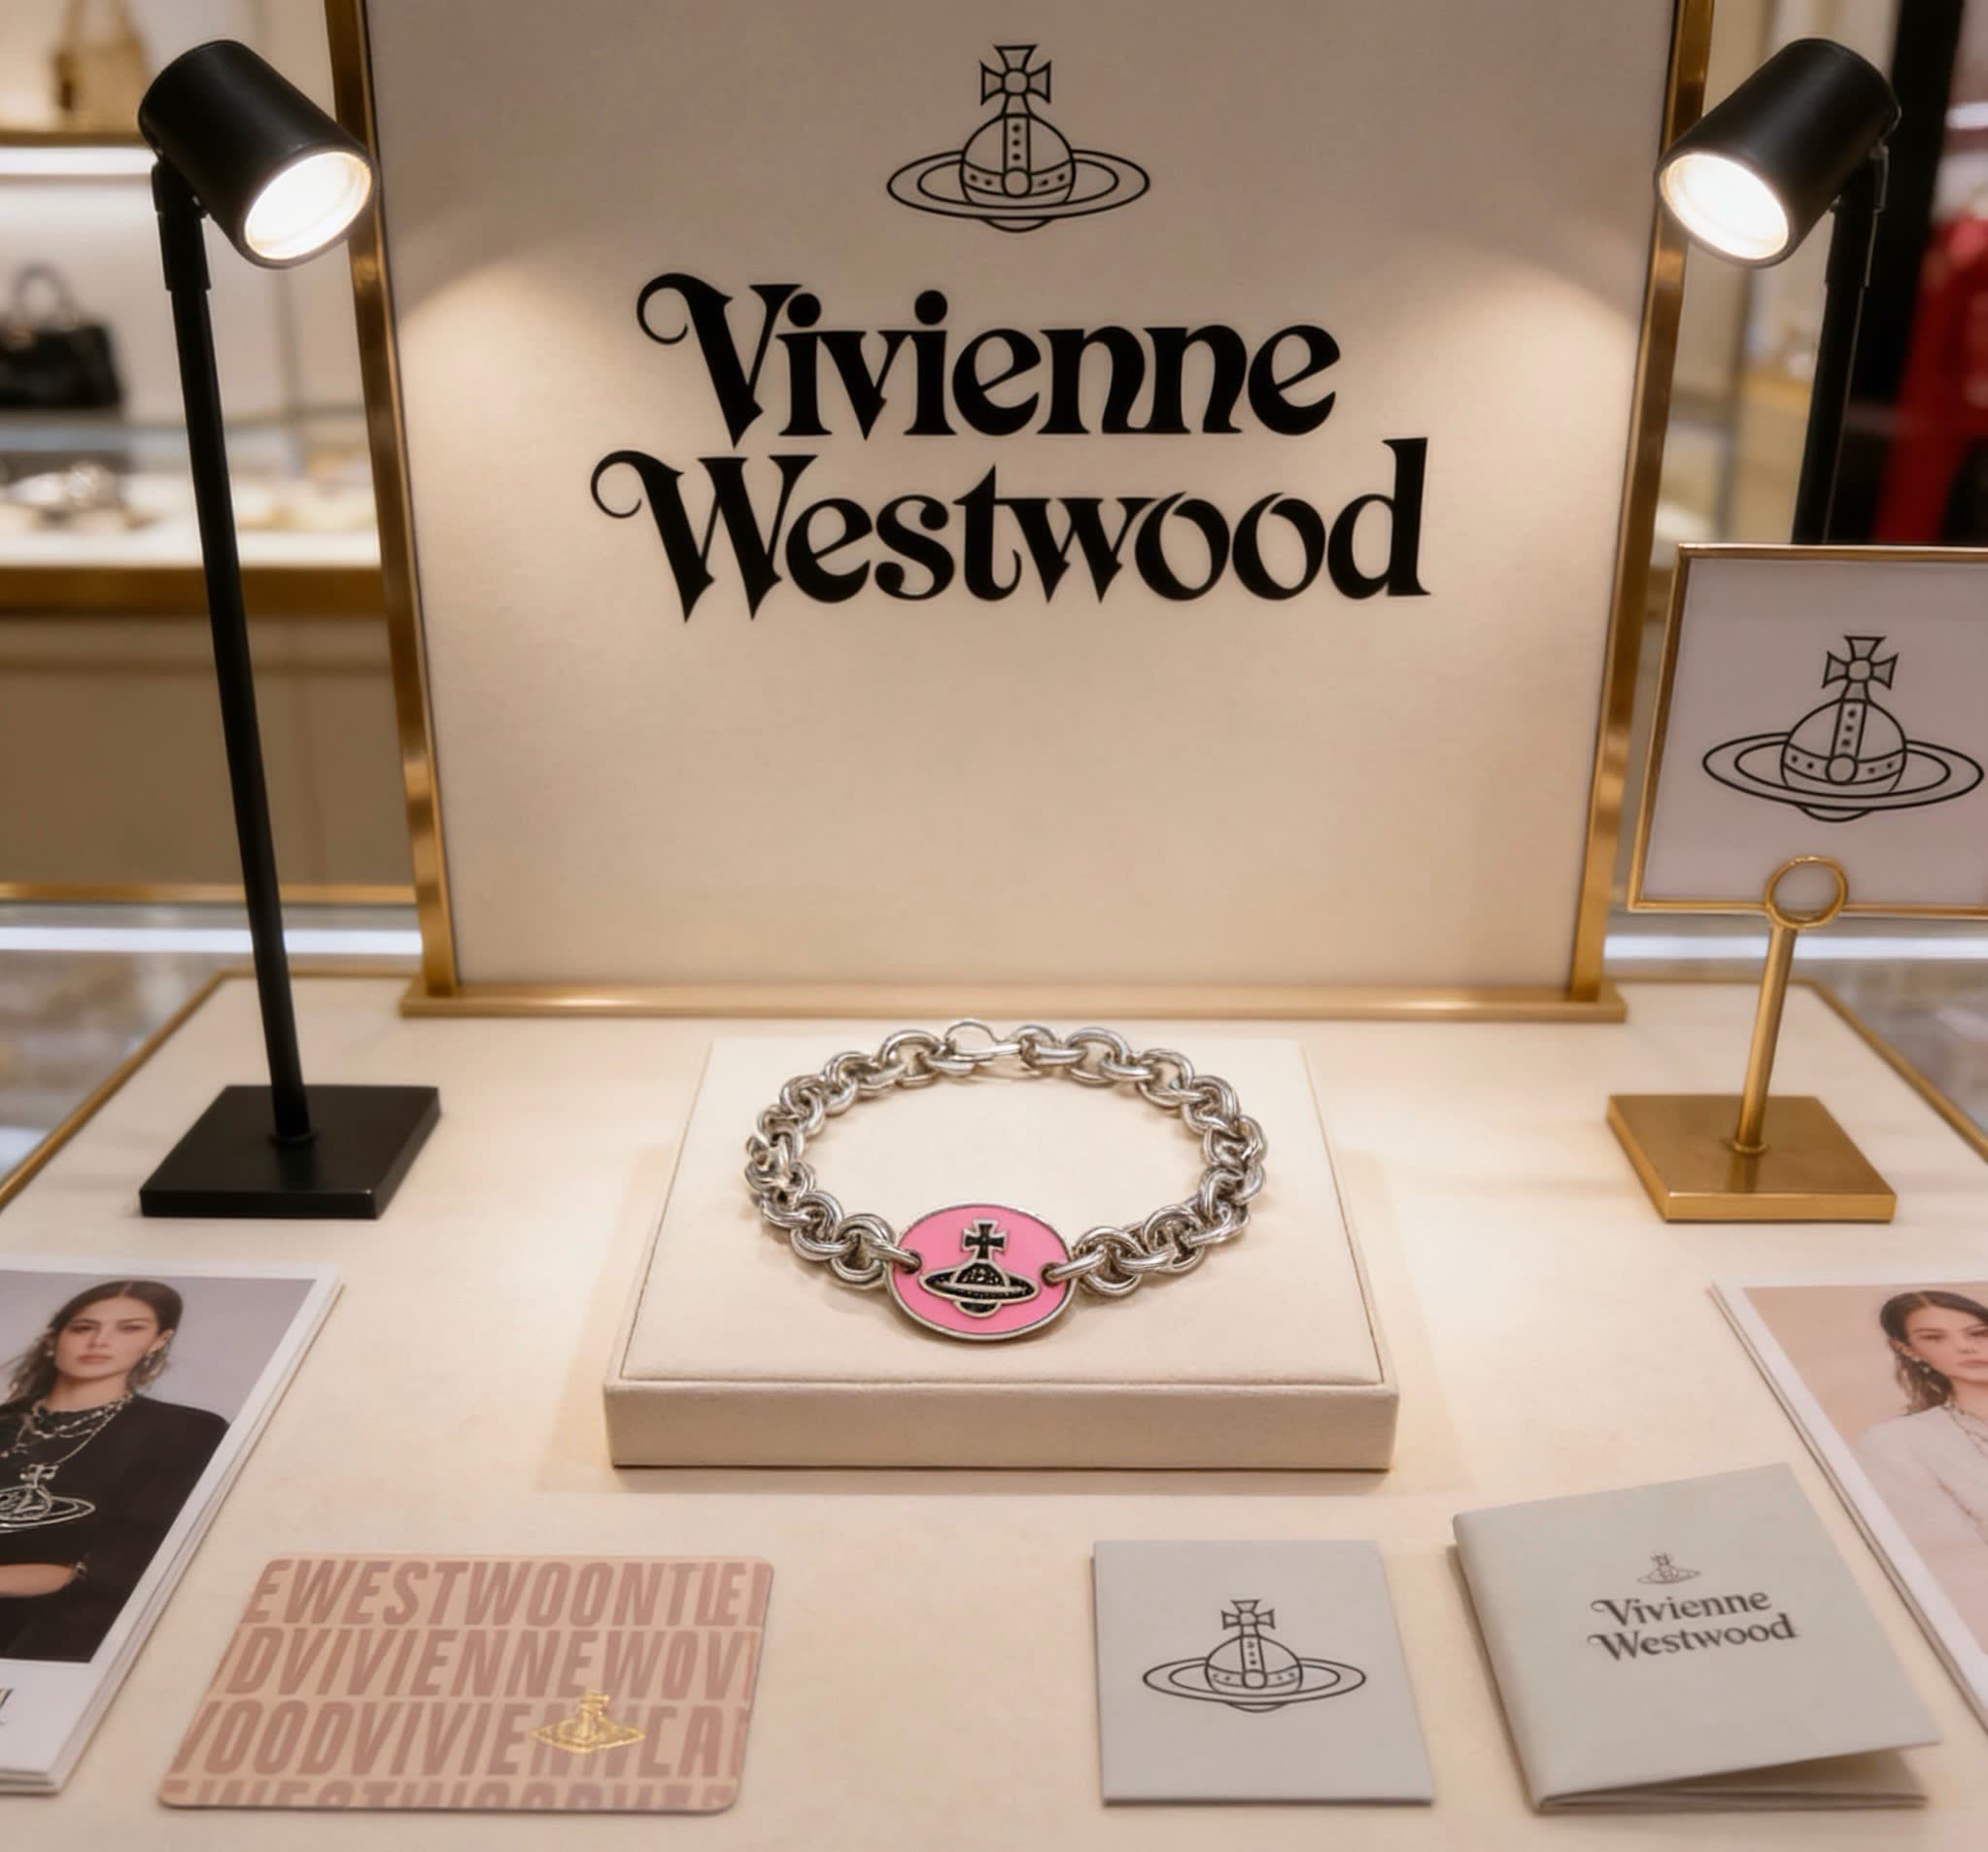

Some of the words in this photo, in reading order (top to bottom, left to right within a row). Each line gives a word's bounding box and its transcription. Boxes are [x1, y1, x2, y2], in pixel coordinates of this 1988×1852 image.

[635, 272, 1341, 449] Vivienne
[590, 437, 1430, 623] Westwood
[1587, 1613, 1800, 1662] Westwood
[1590, 1592, 1772, 1628] Vivienne
